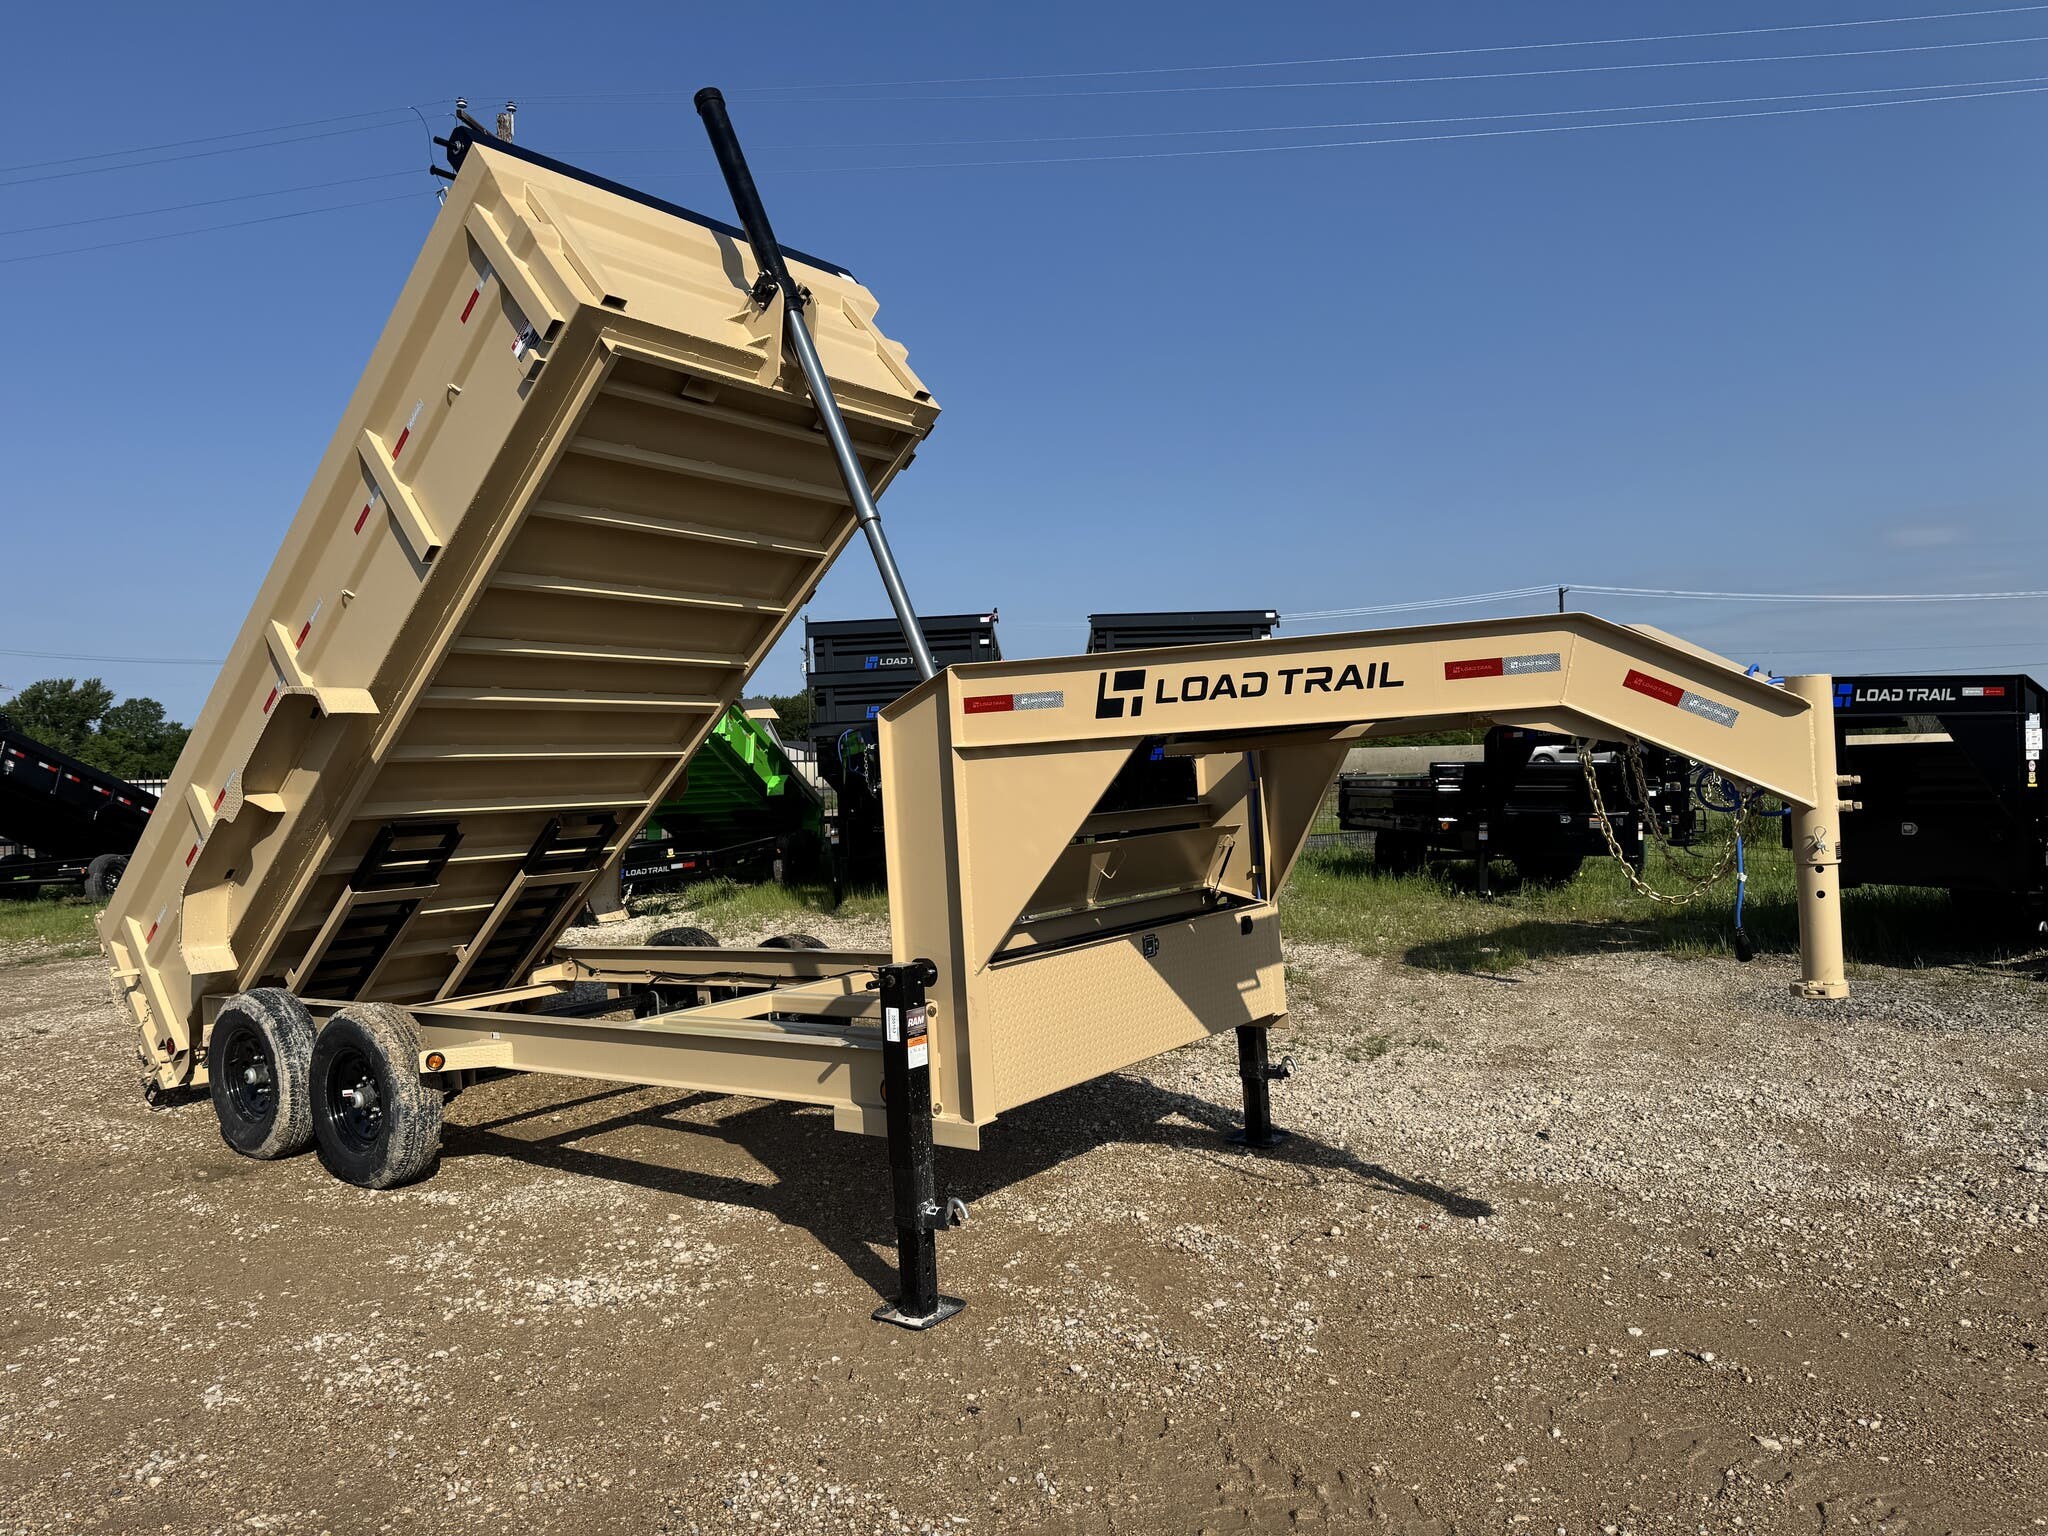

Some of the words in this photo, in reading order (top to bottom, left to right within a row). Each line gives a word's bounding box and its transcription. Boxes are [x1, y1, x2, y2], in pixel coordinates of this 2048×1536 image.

[880, 657, 908, 666] LOAD
[1155, 671, 1269, 704] LOAD
[1278, 661, 1405, 695] TRAIL
[1855, 688, 1903, 702] LOAD
[1906, 687, 1956, 702] TRAIL
[625, 868, 647, 877] LOAD
[648, 865, 670, 875] TRAIL
[907, 1015, 925, 1027] RAM
